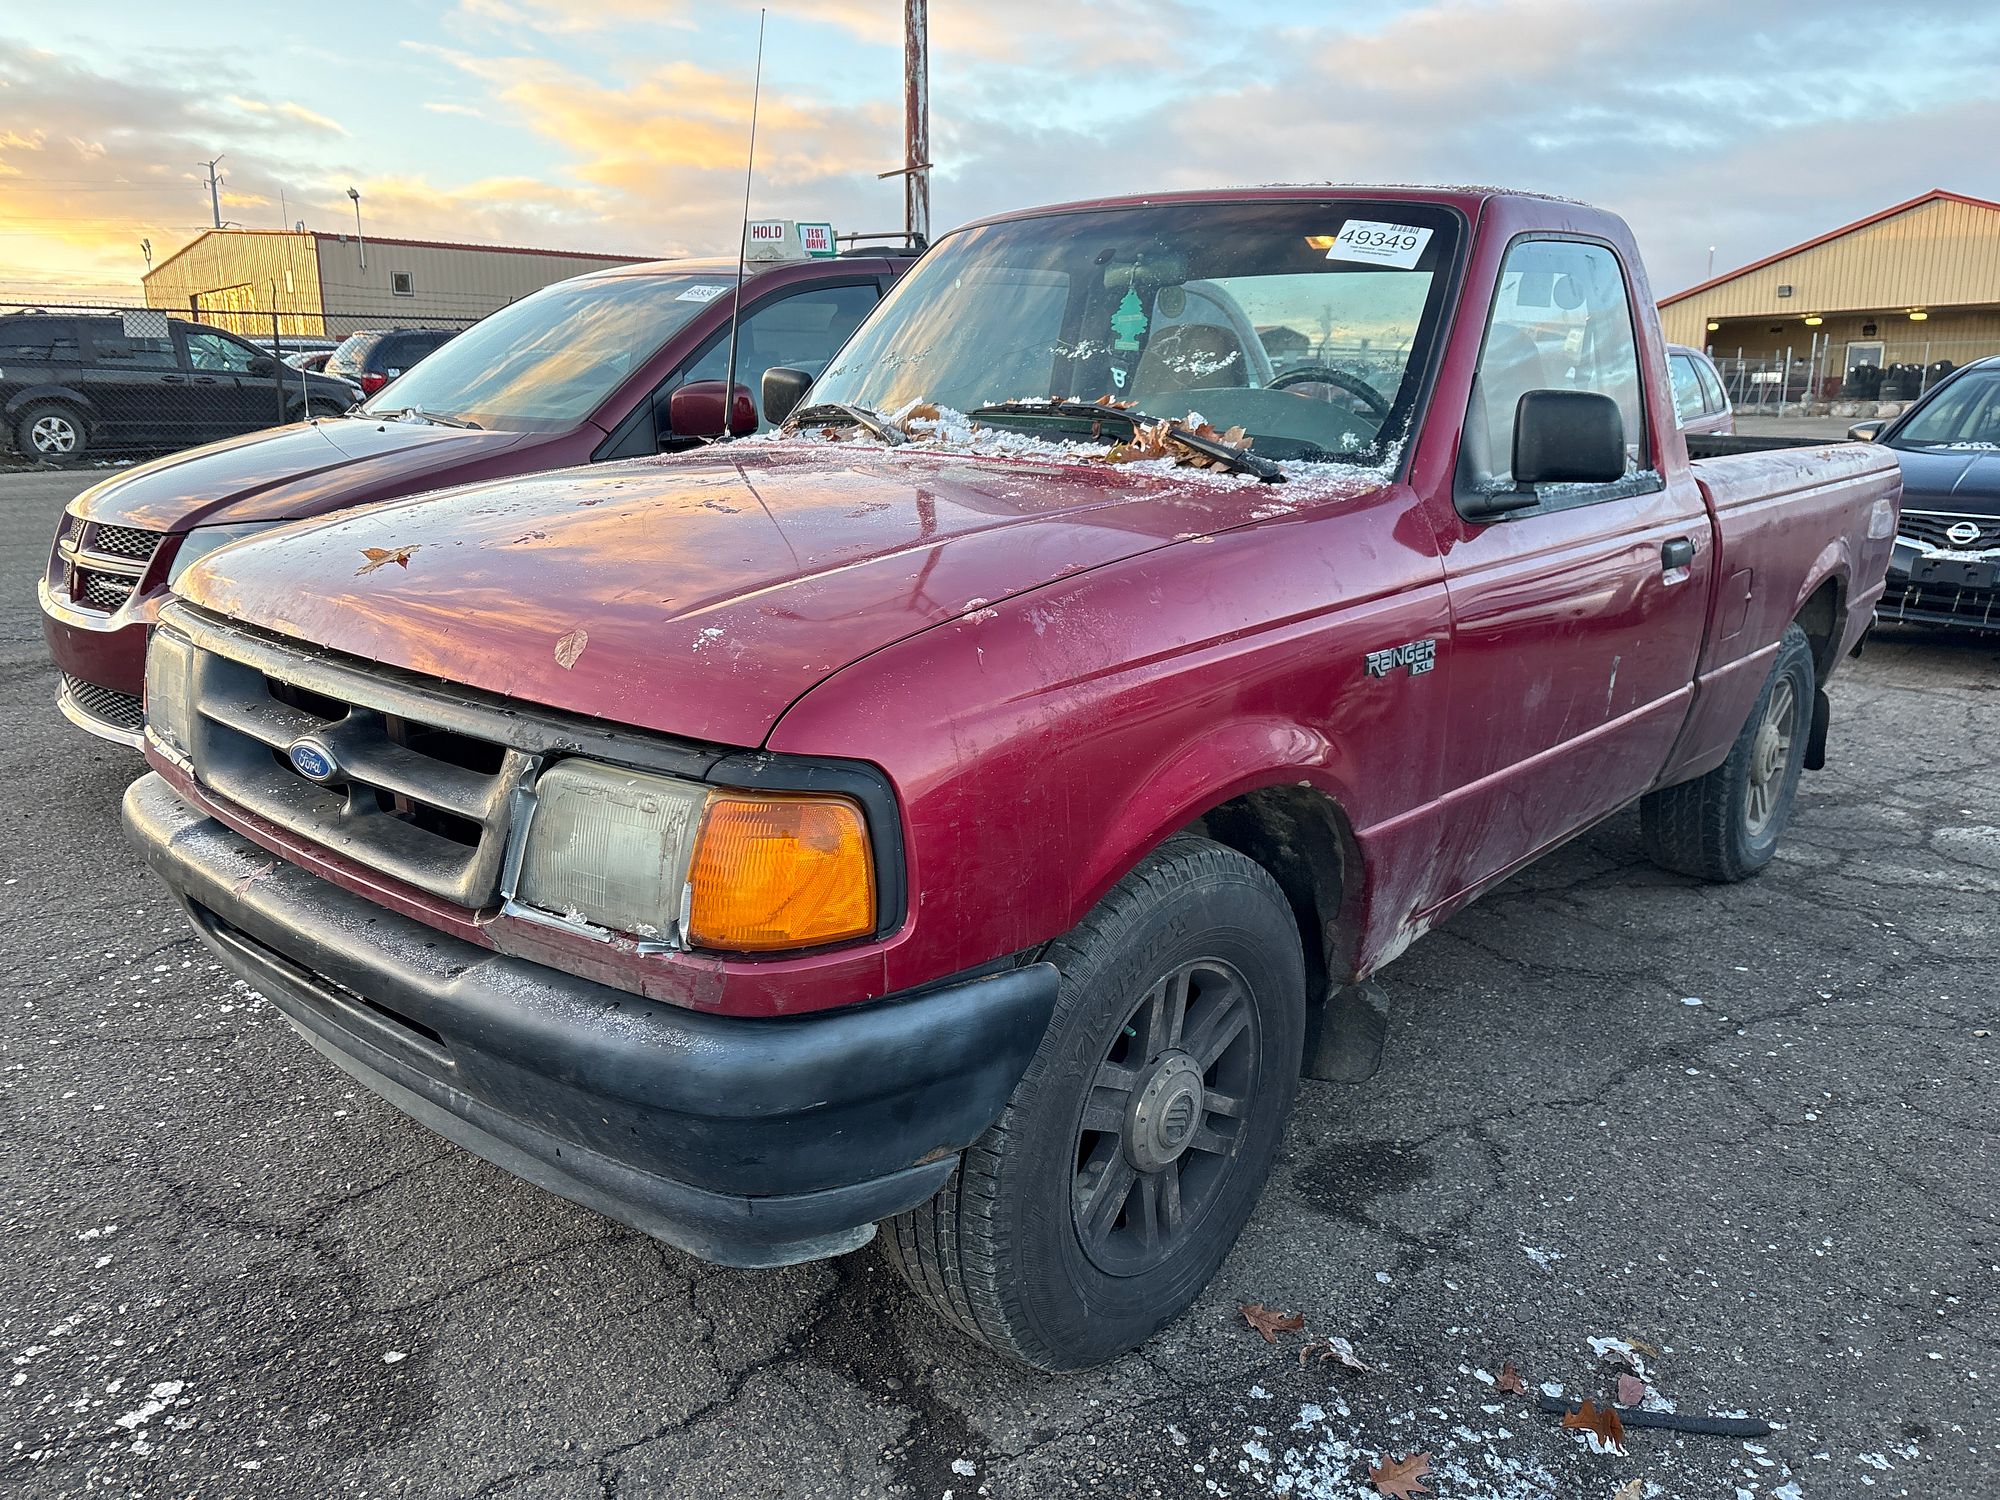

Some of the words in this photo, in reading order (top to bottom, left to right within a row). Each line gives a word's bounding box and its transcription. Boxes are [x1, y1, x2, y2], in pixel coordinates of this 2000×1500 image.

[752, 225, 782, 239] HOLD
[806, 228, 824, 239] TEST
[805, 239, 827, 249] DRIVE
[1339, 229, 1417, 251] 49349
[1366, 639, 1436, 677] RANGER
[1415, 662, 1432, 673] XL
[298, 748, 322, 774] Ford
